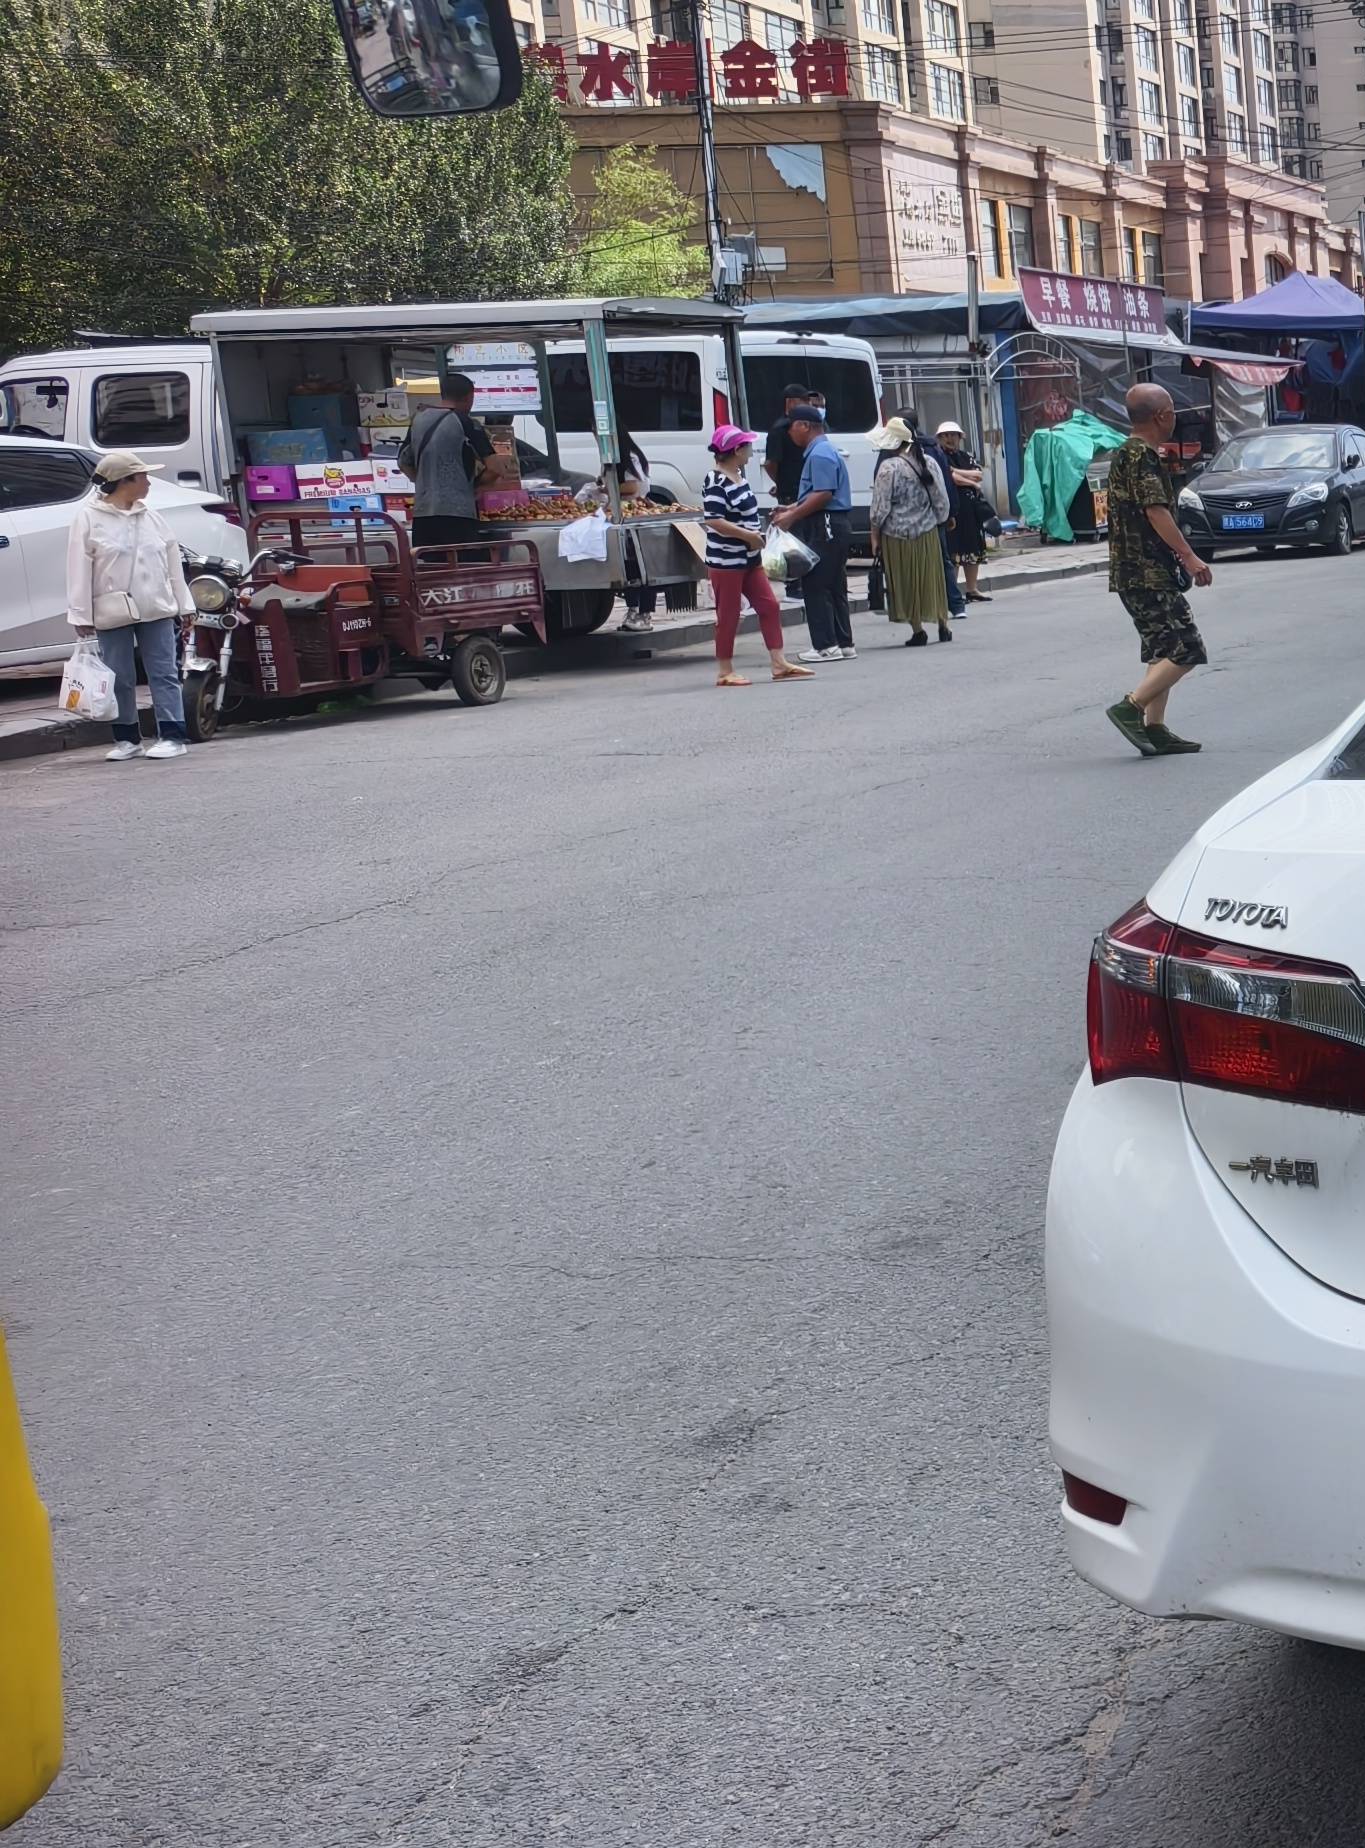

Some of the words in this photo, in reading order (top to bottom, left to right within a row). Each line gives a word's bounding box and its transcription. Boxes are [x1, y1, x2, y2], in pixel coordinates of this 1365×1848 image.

[1039, 276, 1072, 310] 早餐
[1082, 281, 1112, 315] 烧饼
[1122, 287, 1150, 319] 油条
[304, 489, 337, 499] PREMIUM
[419, 586, 465, 606] 大江
[1204, 897, 1289, 930] TOYOTA
[1228, 1155, 1320, 1189] 一汽丰田
